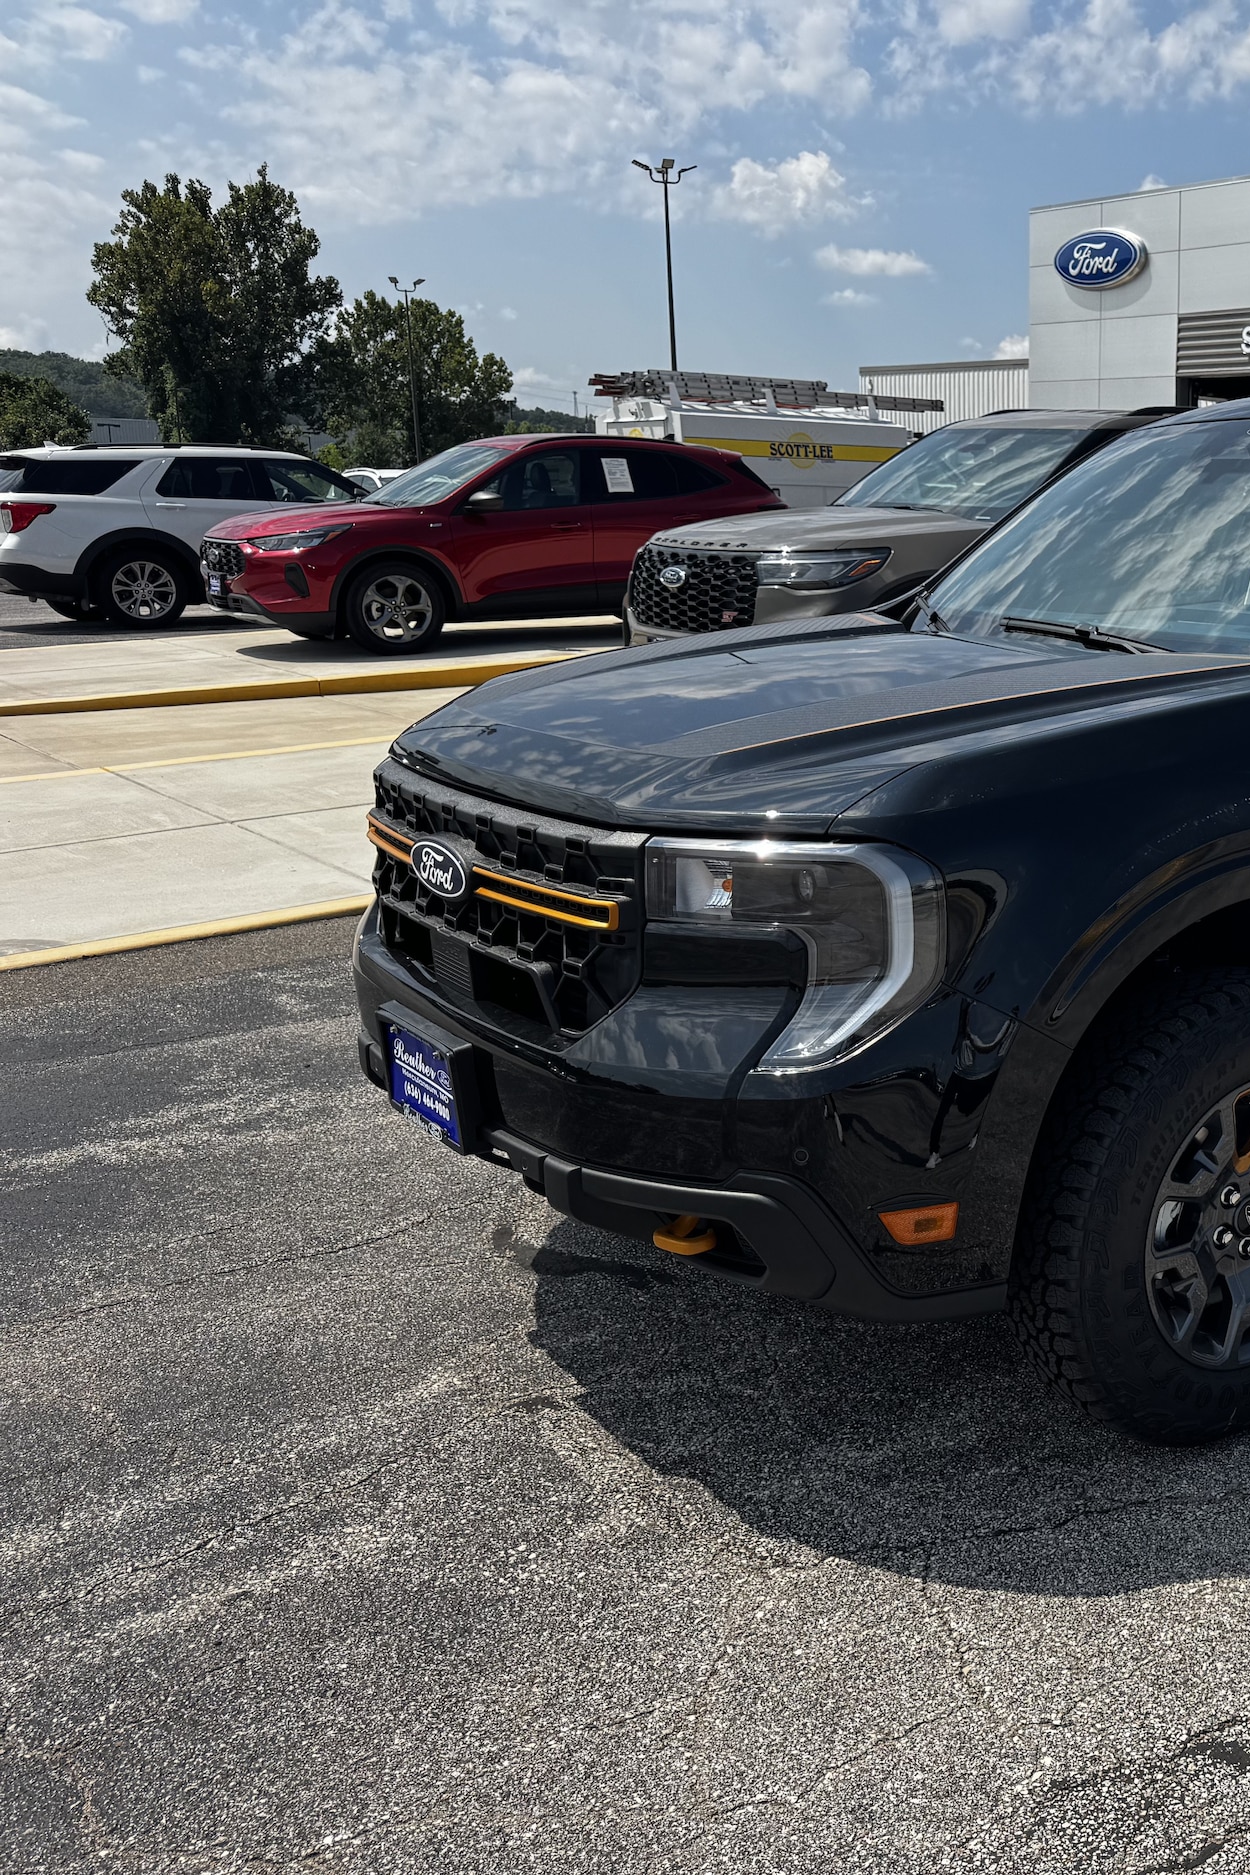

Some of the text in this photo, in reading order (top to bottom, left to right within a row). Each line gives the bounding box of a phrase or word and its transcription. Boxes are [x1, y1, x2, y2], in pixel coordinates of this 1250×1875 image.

[1068, 241, 1119, 277] Ford
[769, 442, 834, 459] SCOTT-LEE
[420, 847, 454, 891] Ford
[394, 1038, 436, 1080] Reuther
[404, 1080, 421, 1105] (636)
